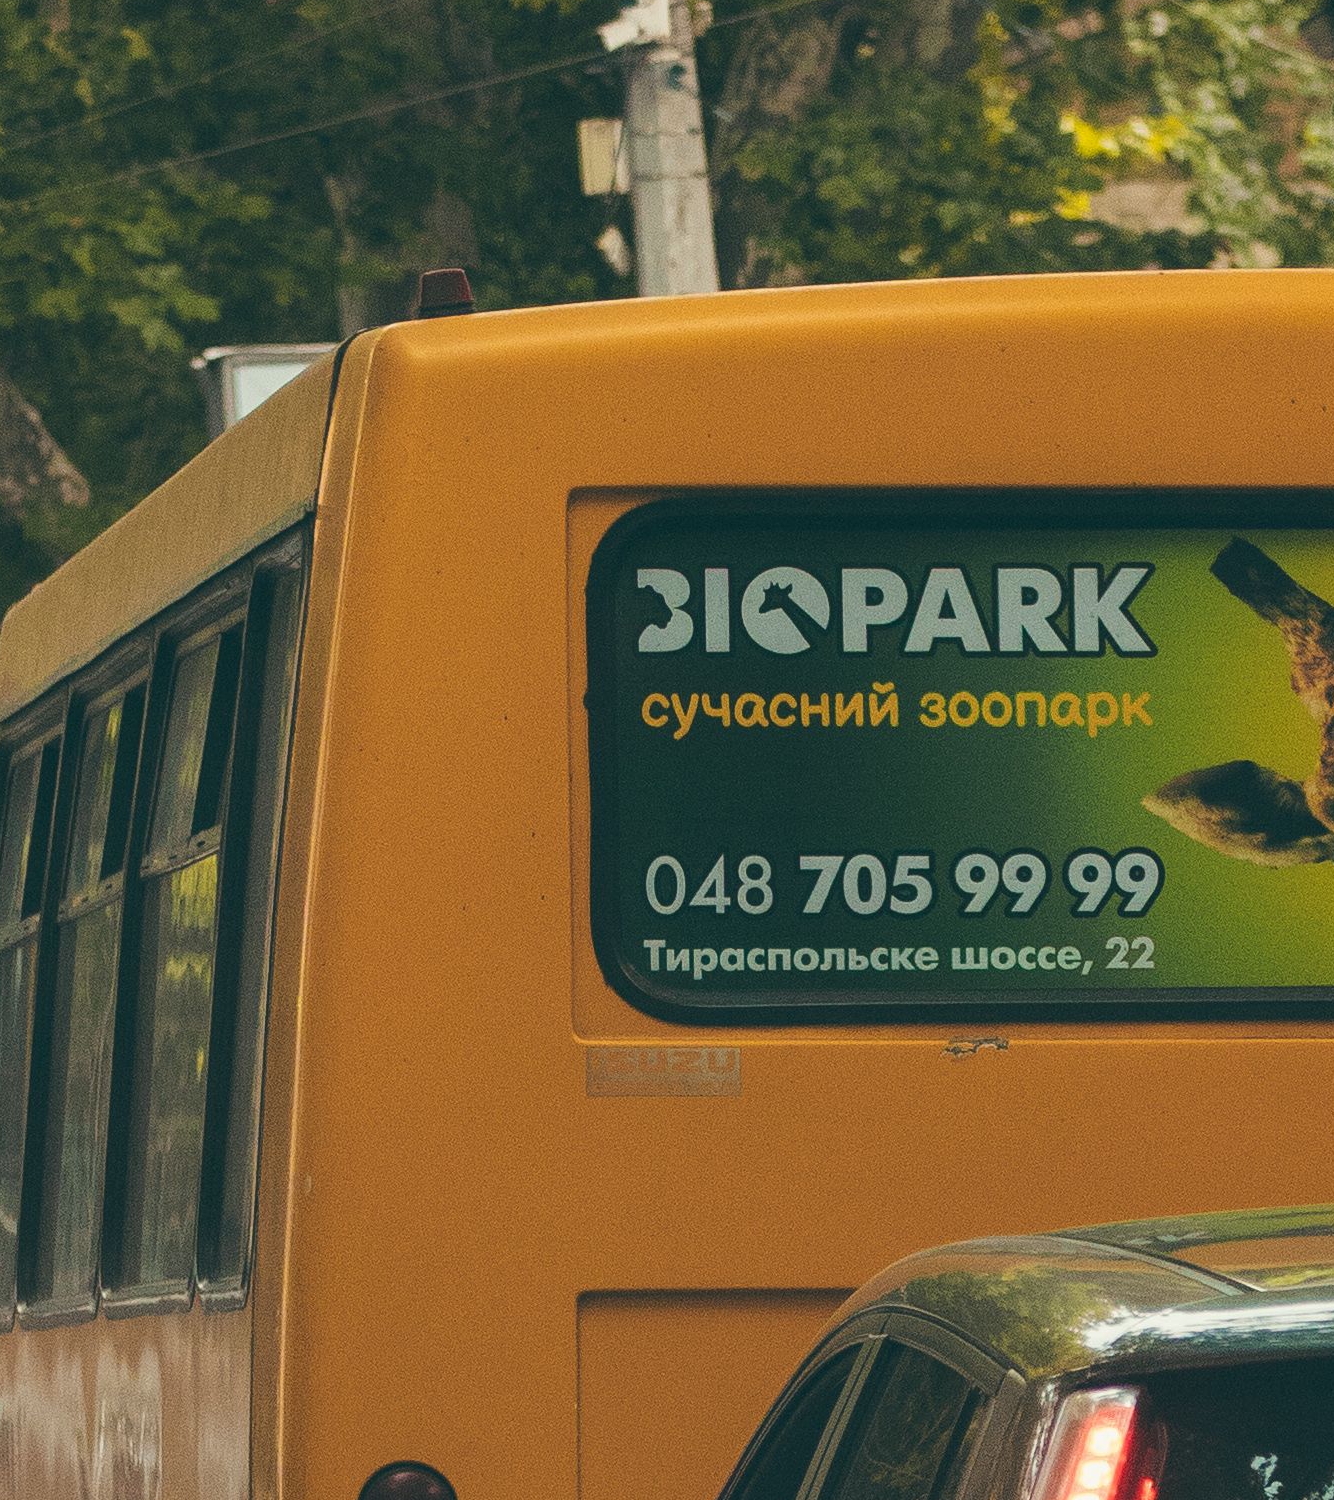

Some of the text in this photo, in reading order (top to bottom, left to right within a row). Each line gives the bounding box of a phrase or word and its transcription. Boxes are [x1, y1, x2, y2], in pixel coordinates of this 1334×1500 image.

[637, 566, 1150, 654] BIOPARK
[641, 681, 1155, 740] сучасний зоопарк
[645, 852, 1162, 915] 048 705 99 99
[643, 936, 1156, 980] Тираспольске шоссе, 22
